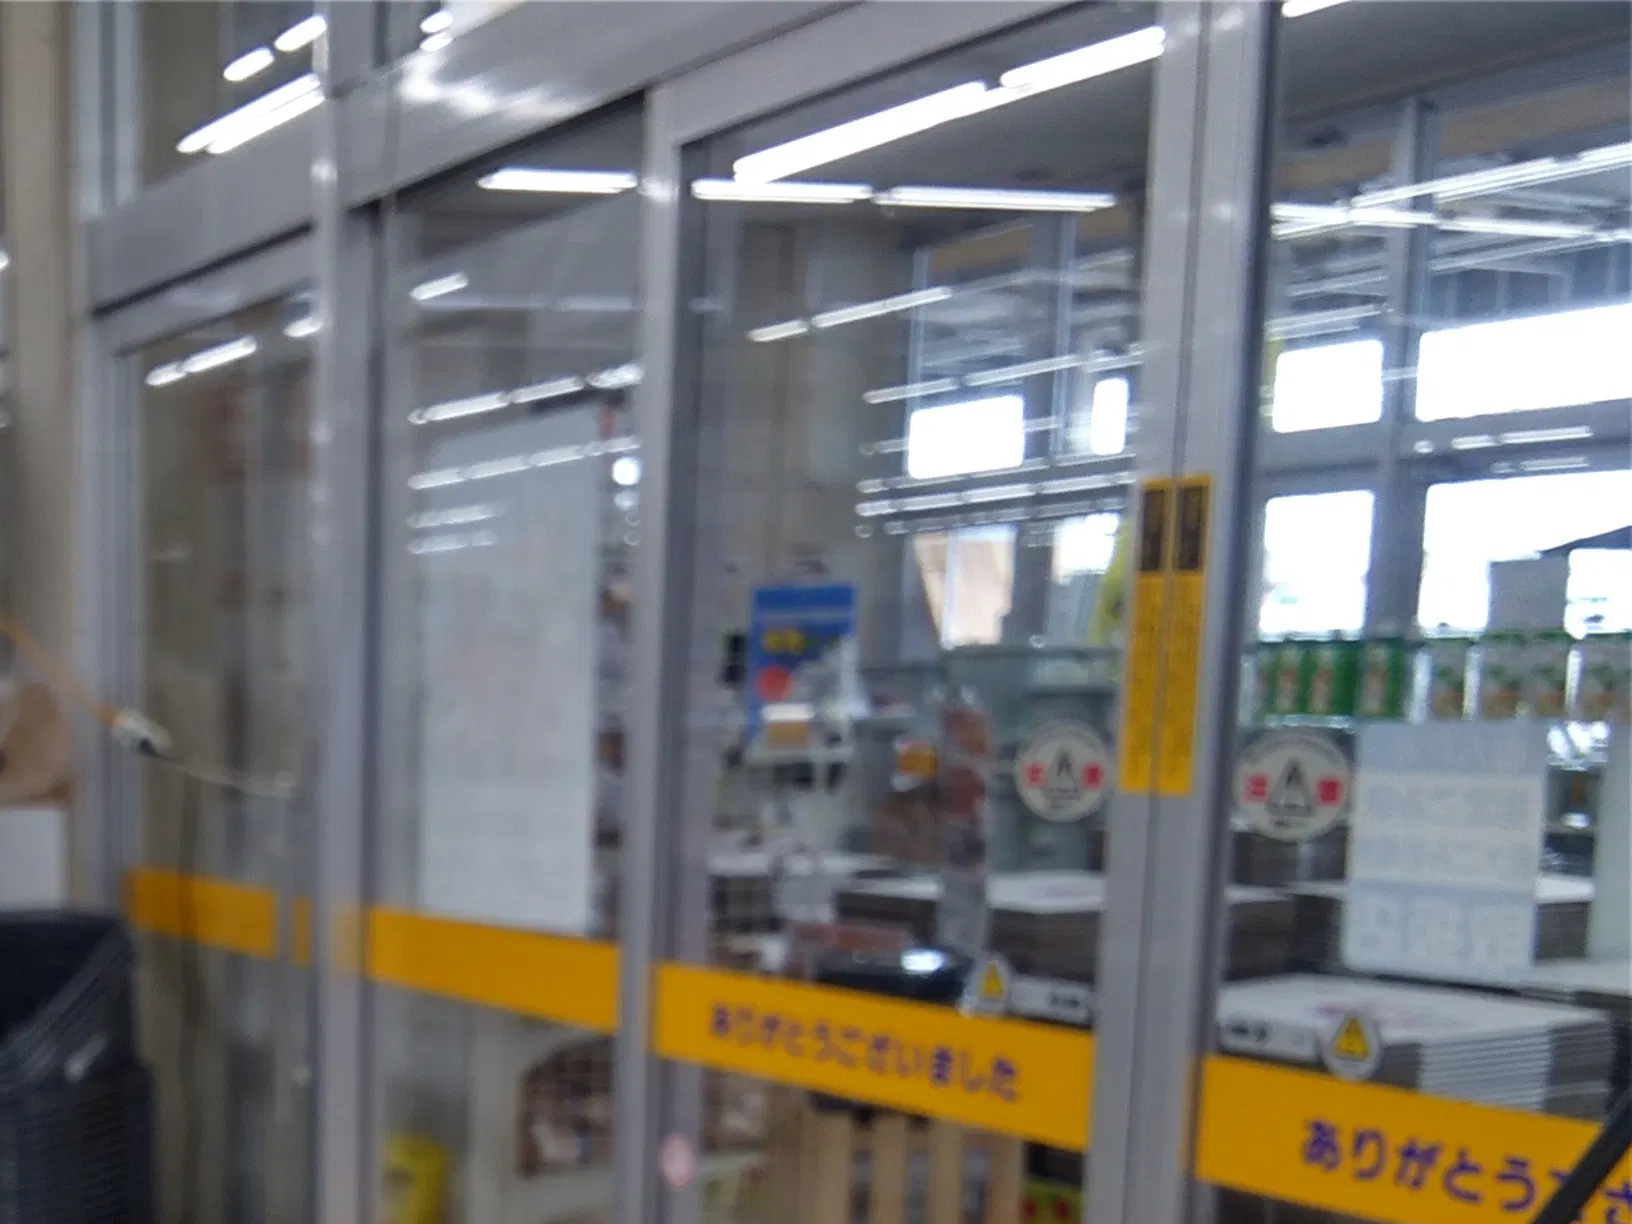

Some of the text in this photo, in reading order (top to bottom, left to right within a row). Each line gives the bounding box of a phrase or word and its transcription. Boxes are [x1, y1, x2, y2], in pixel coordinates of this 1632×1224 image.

[711, 1000, 1020, 1102] ありがとうございました
